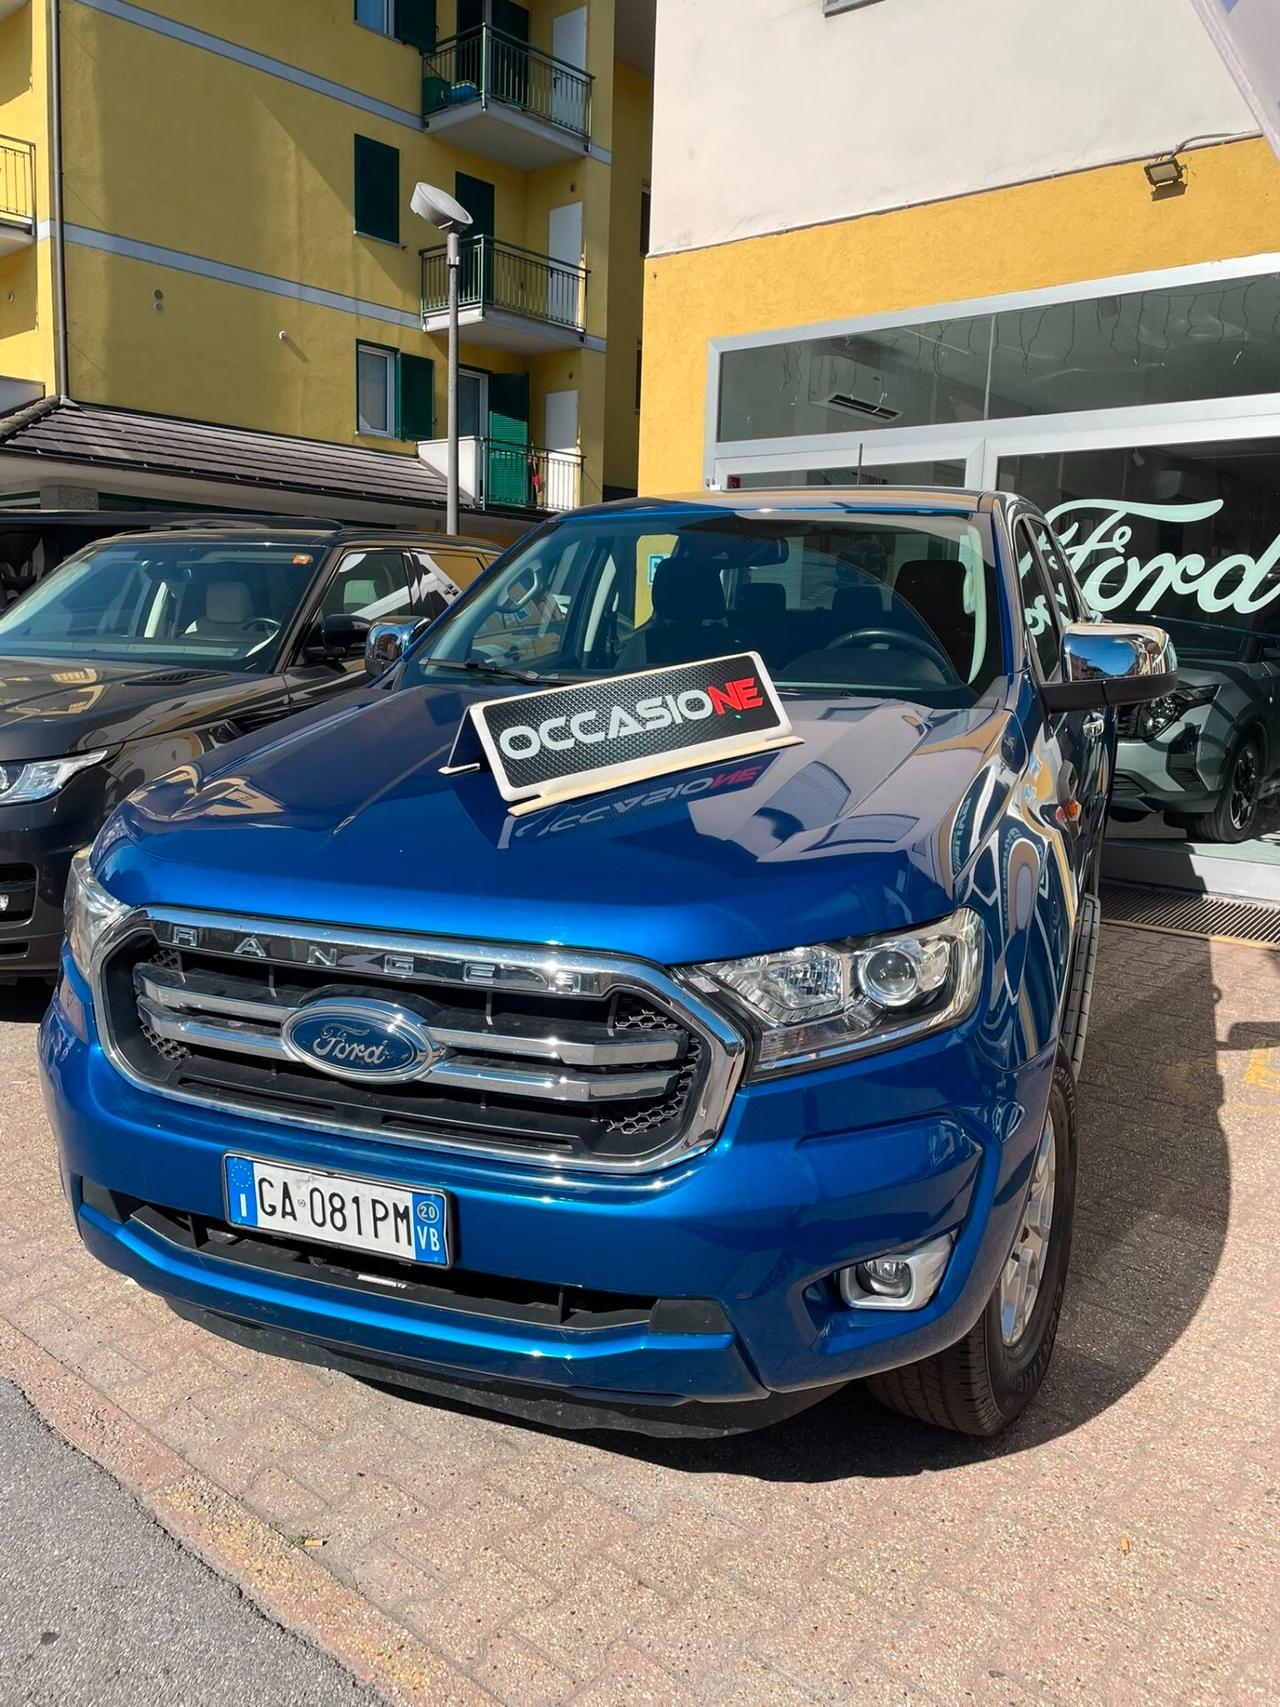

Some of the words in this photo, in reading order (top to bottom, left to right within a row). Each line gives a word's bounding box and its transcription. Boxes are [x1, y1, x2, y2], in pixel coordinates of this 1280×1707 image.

[1045, 498, 1280, 614] Ford
[499, 677, 764, 760] OCCASIONE
[172, 926, 582, 993] RANGER
[313, 1022, 389, 1065] Ford
[257, 1177, 297, 1221] GA
[308, 1187, 413, 1247] 081PM
[416, 1225, 440, 1251] VB
[420, 1204, 436, 1219] 20
